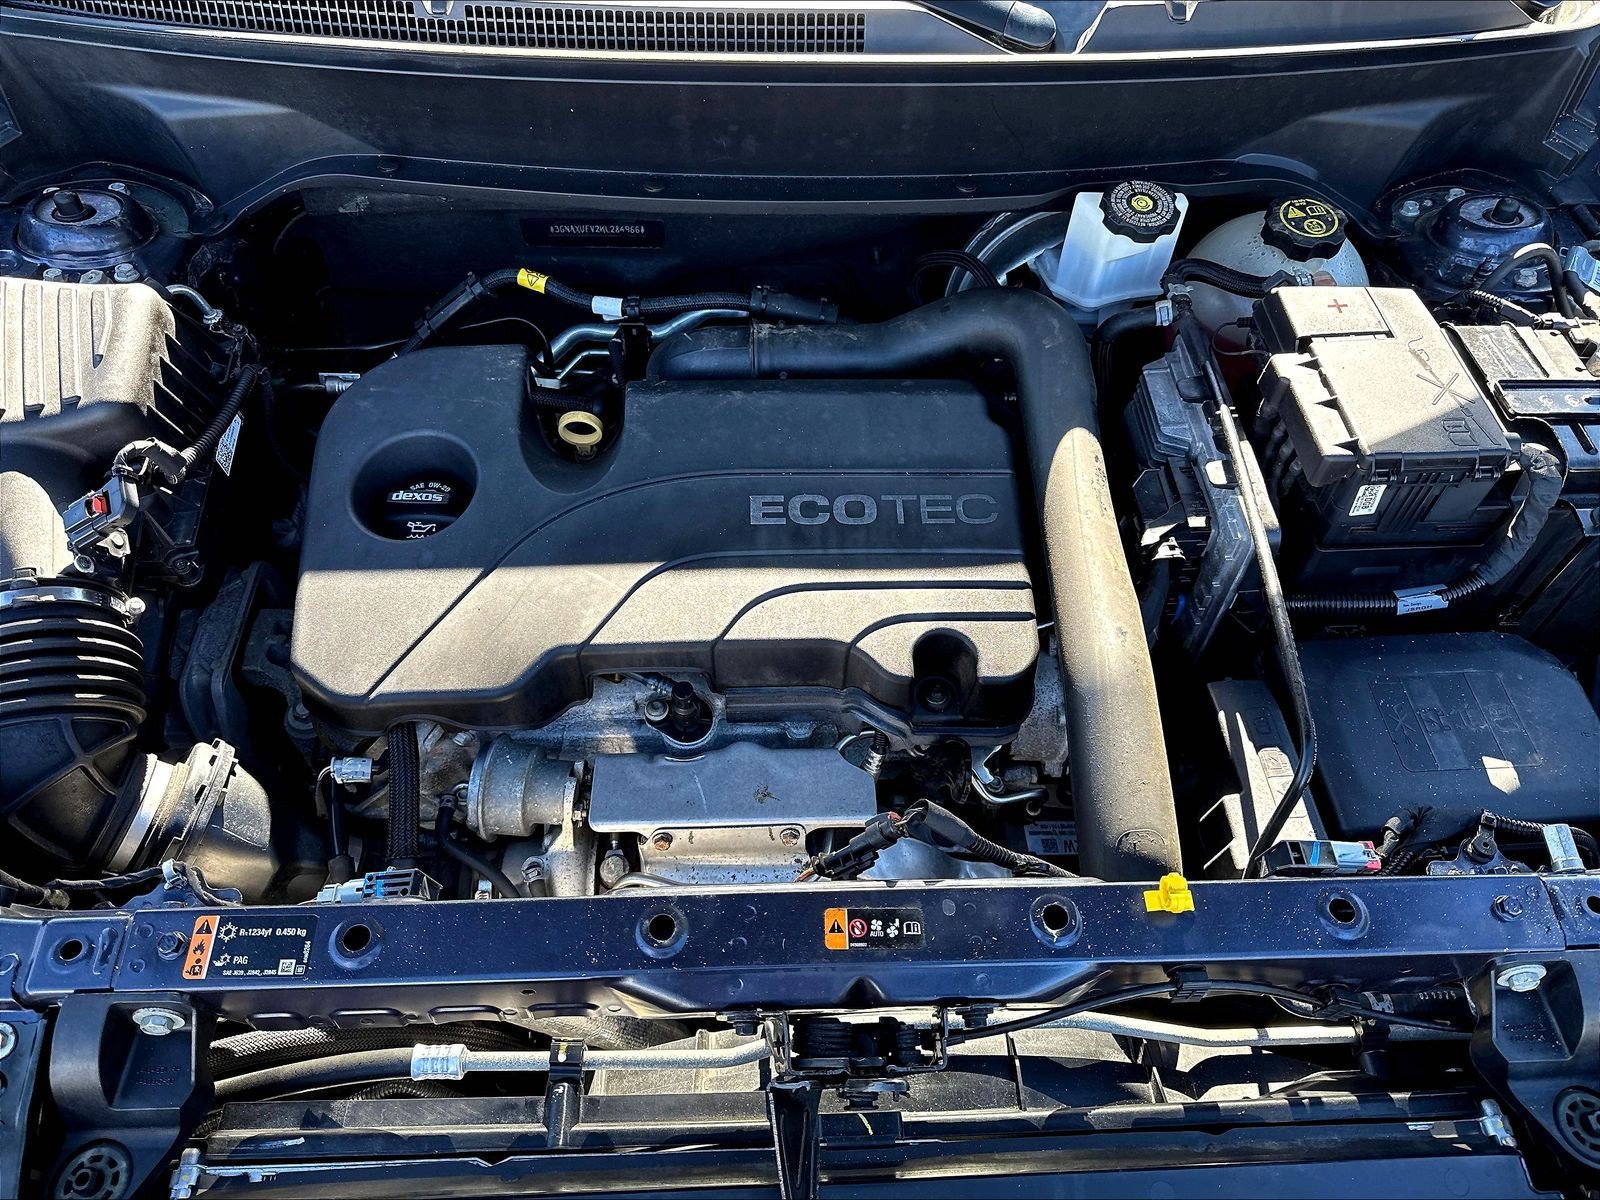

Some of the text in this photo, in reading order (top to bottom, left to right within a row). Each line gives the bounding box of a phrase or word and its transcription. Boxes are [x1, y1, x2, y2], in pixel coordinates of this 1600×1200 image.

[410, 482, 425, 491] SAE
[391, 490, 445, 502] dexos
[749, 493, 999, 525] ECOTEC
[276, 927, 297, 937] 0.450
[296, 927, 307, 938] kg
[233, 955, 249, 965] PAG
